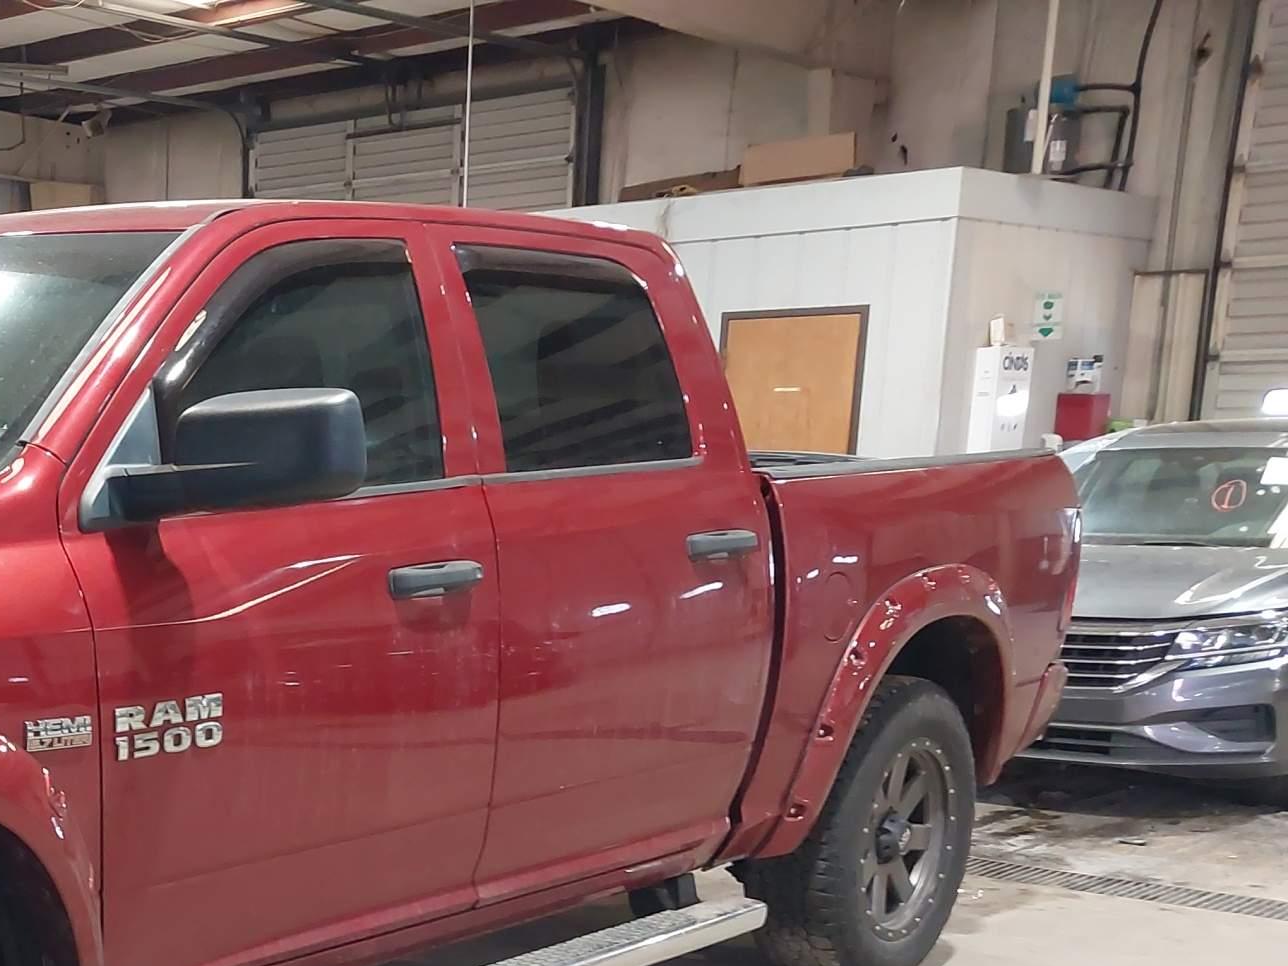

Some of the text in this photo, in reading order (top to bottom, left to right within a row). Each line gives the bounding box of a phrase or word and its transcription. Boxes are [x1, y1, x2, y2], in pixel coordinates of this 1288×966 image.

[24, 715, 92, 737] HEMI
[114, 692, 224, 733] RAM
[114, 721, 224, 761] 1500
